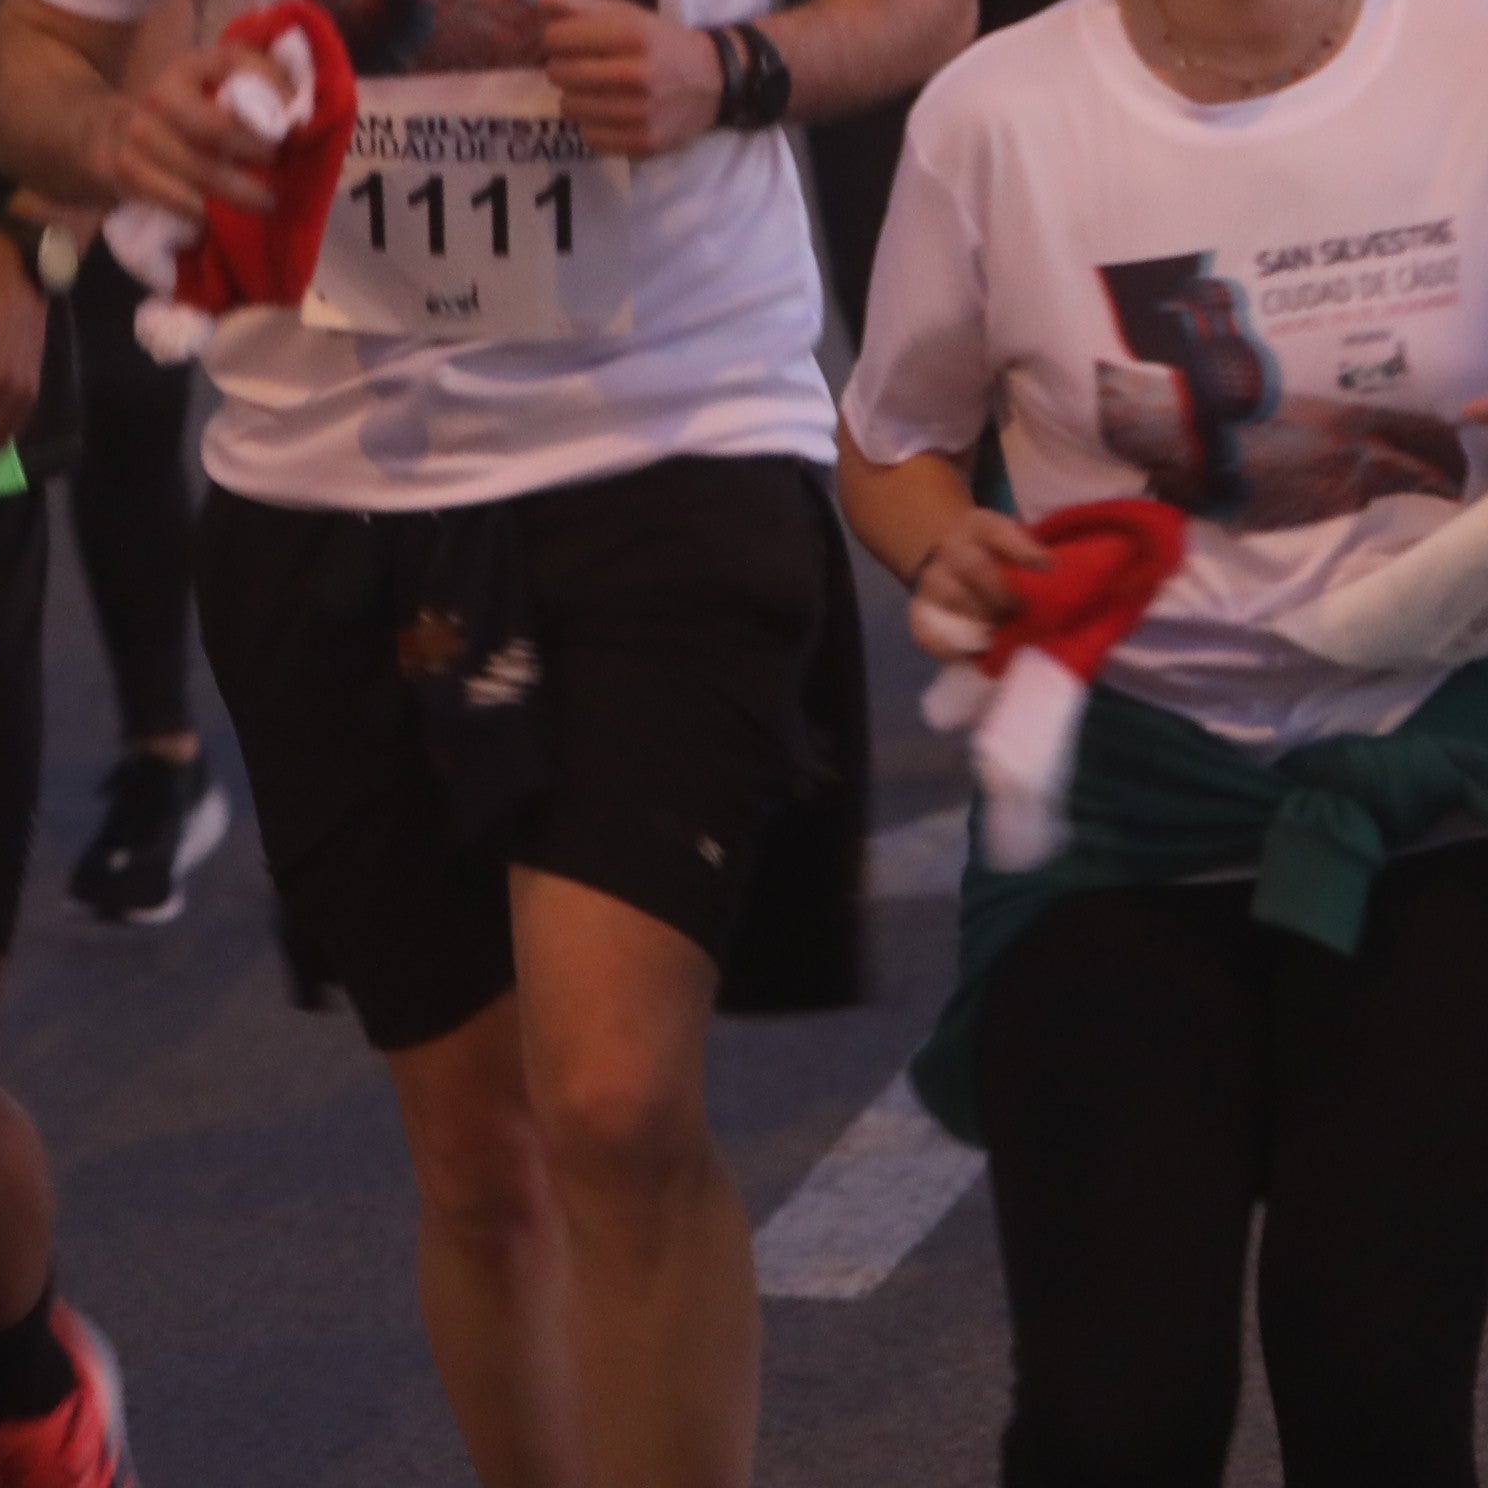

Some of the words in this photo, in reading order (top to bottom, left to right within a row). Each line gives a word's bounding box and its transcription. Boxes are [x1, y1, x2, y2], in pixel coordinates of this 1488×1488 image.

[348, 170, 574, 258] 1111
[1256, 247, 1312, 278] SAN
[1318, 216, 1455, 268] SILVESTRE
[1260, 278, 1353, 318] CIUDAD
[1360, 269, 1388, 300] DE
